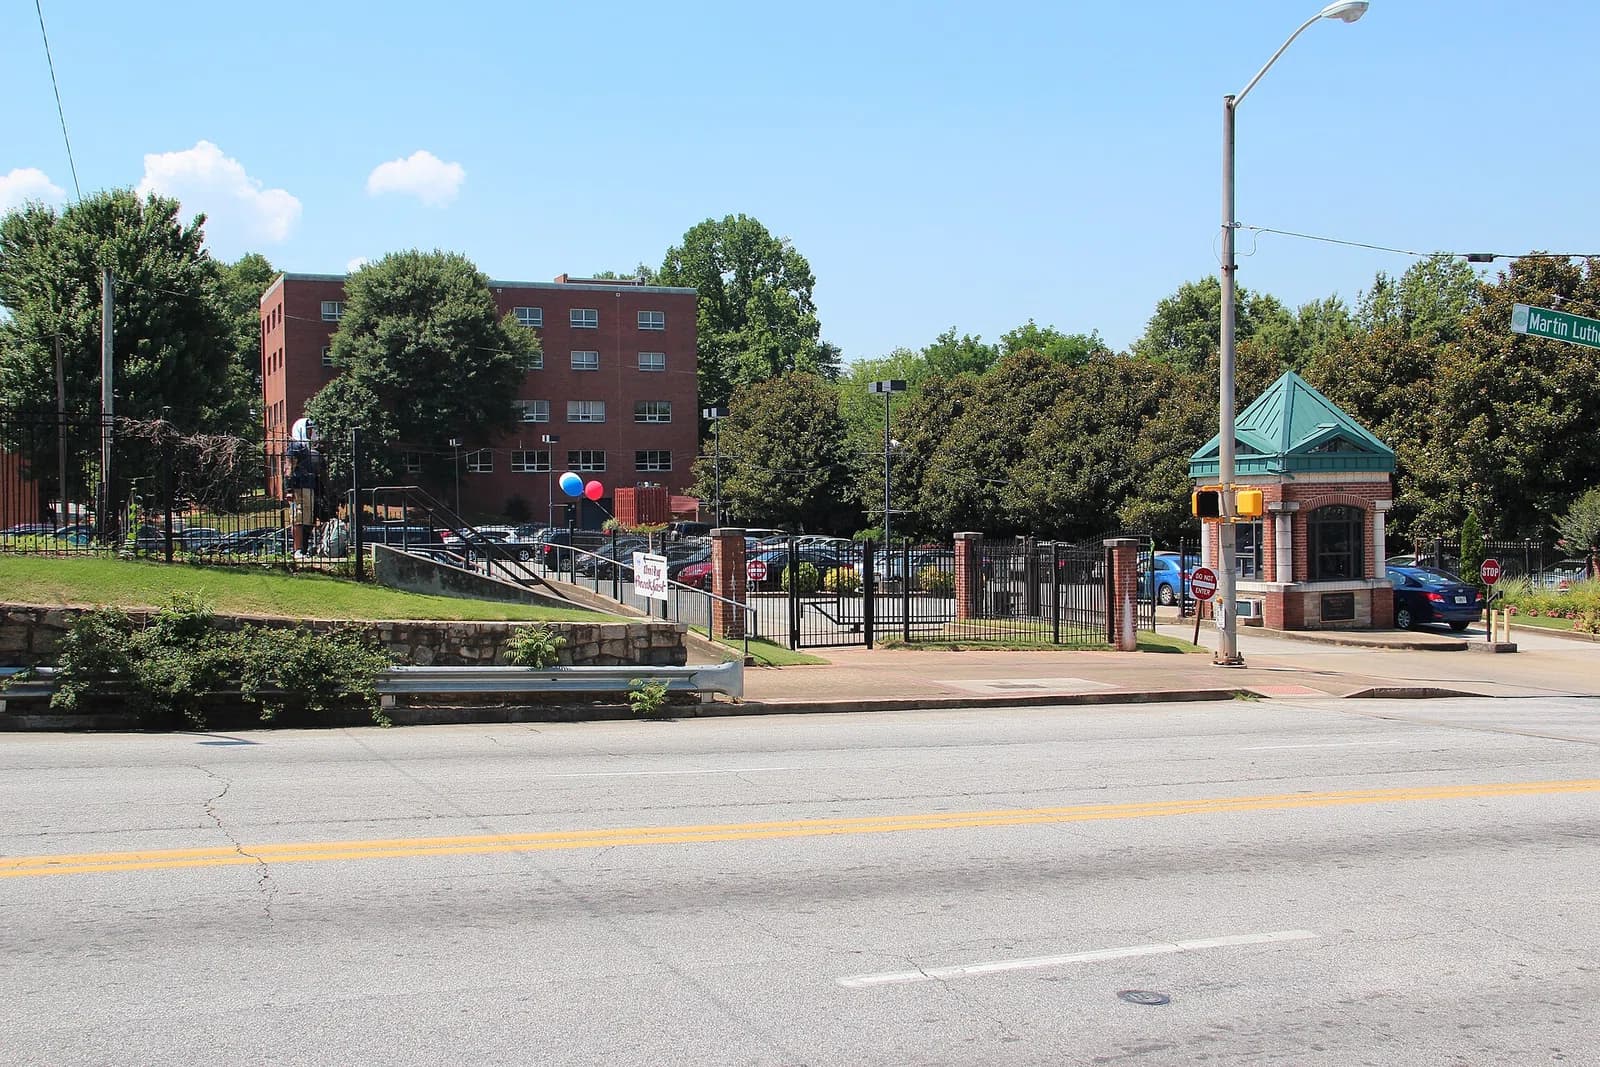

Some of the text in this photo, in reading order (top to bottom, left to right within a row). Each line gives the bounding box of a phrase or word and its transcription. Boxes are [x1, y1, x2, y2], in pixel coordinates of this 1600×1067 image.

[1528, 312, 1568, 337] Martin
[1482, 567, 1499, 577] STOP
[1195, 587, 1211, 595] ENTER
